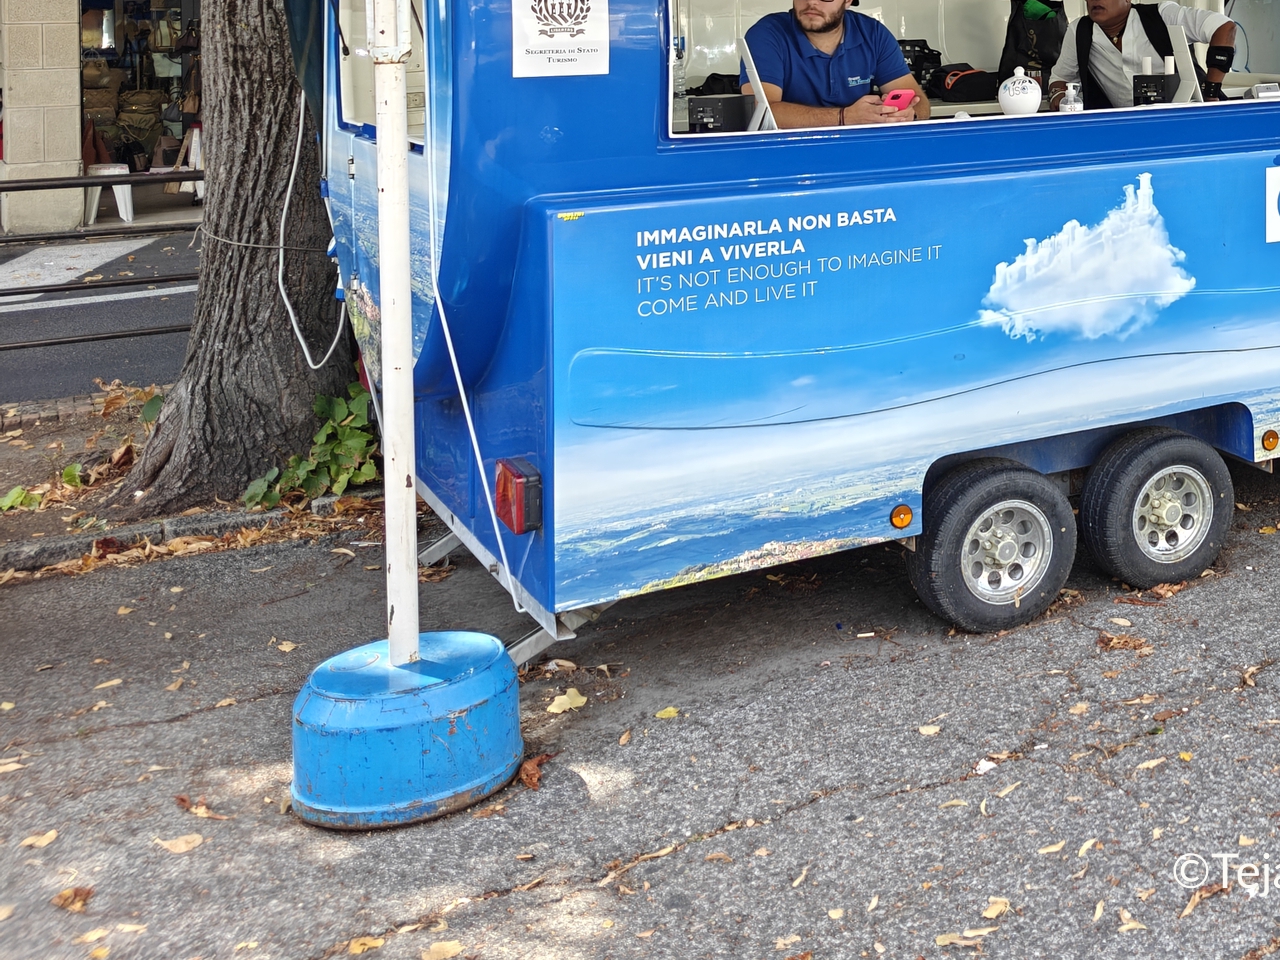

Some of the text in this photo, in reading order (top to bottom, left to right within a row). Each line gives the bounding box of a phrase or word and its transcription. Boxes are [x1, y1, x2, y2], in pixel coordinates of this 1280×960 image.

[636, 208, 897, 247] IMMAGINARLA NON BASTA
[636, 238, 806, 270] VIENI A VIVERLA
[637, 245, 942, 294] IT'S NOT ENOUGH TO IMAGINE IT
[637, 280, 818, 317] COME AND LIVE IT
